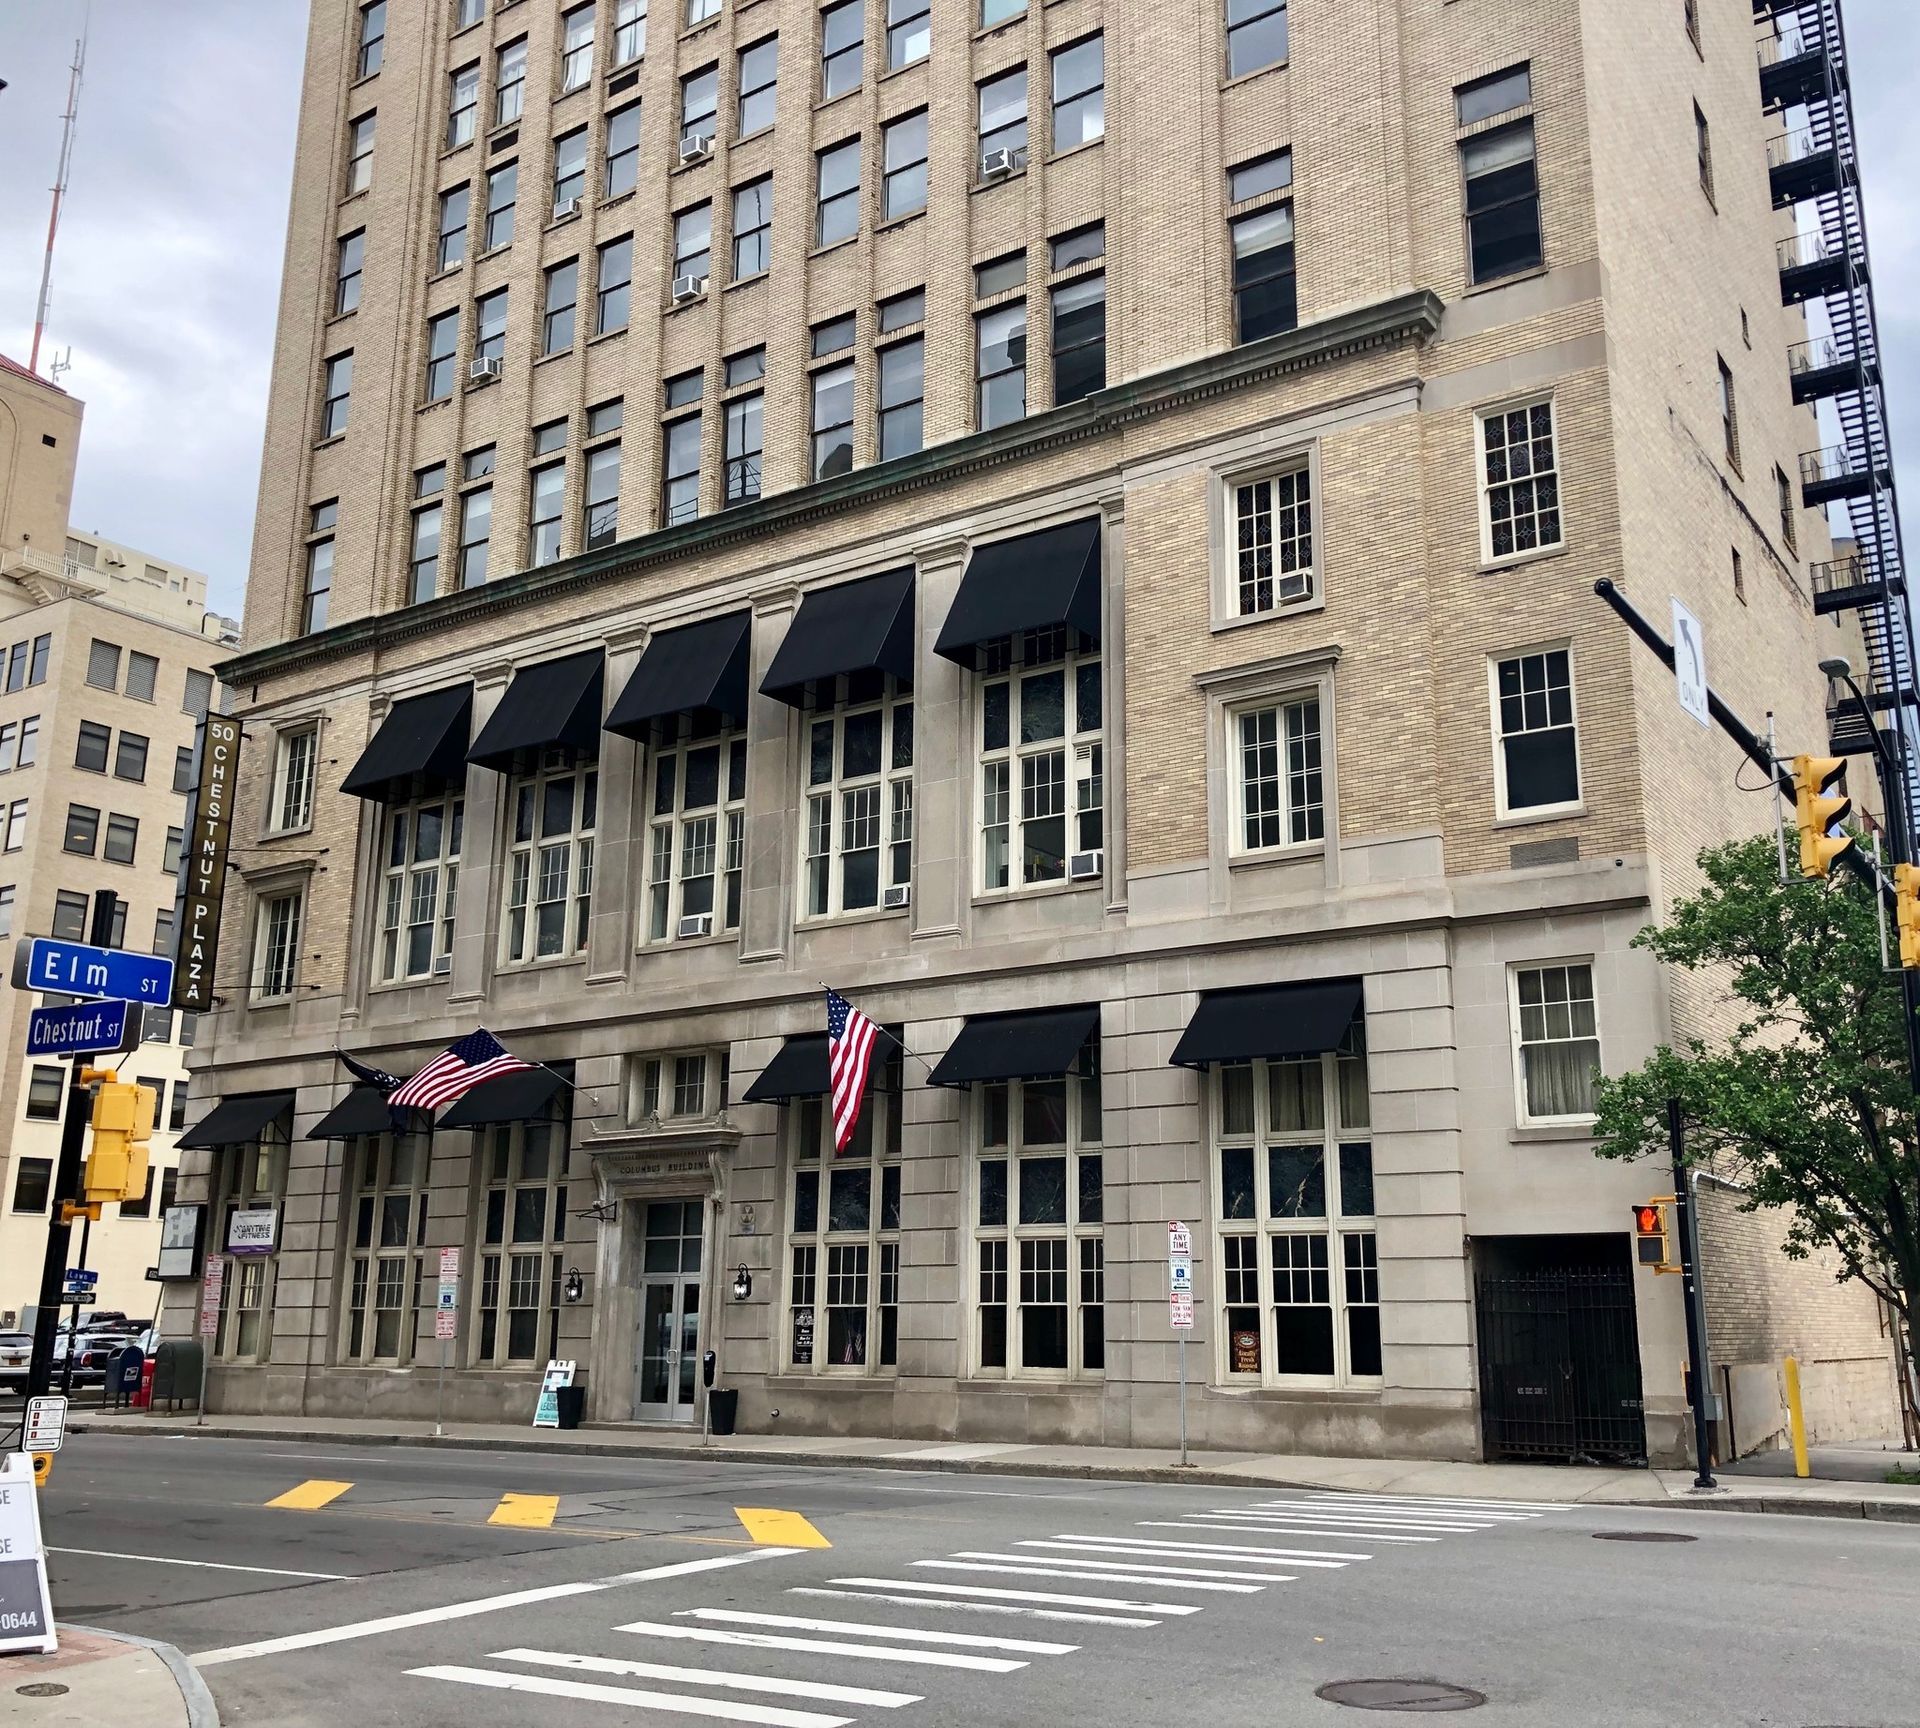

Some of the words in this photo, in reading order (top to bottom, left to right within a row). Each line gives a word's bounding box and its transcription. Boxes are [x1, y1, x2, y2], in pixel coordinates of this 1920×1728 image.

[1682, 681, 1704, 713] ONLY
[210, 723, 234, 742] 50
[199, 744, 229, 895] CHESTNUT
[186, 903, 208, 1000] PLAZA
[44, 951, 109, 987] Elm
[140, 977, 159, 994] ST
[33, 1013, 103, 1046] Chestnut
[106, 1022, 120, 1038] ST
[620, 1164, 661, 1174] COLUMBUS
[667, 1161, 710, 1172] BUILDING
[1172, 1241, 1188, 1249] TIME
[1173, 1233, 1187, 1241] ANY
